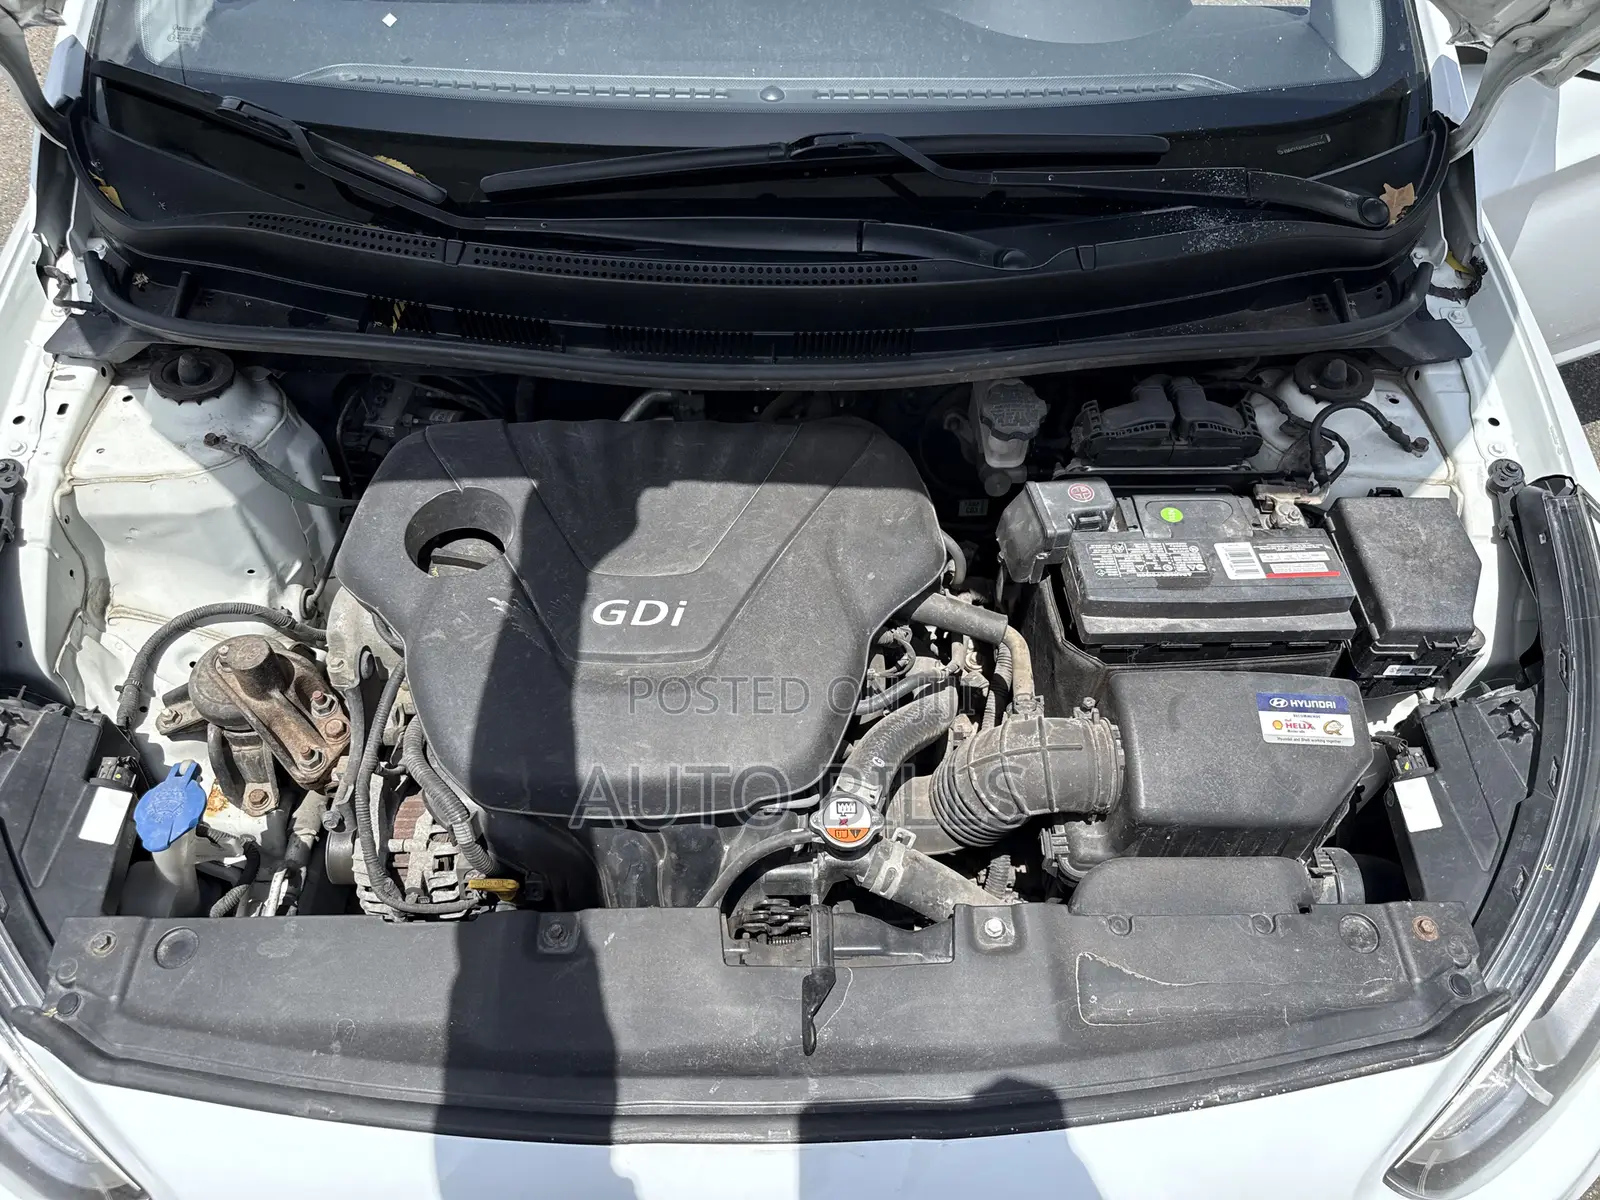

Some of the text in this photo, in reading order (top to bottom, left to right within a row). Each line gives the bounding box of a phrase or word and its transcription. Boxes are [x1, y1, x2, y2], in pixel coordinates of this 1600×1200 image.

[592, 600, 688, 627] GDi
[1290, 699, 1336, 709] HYUNDAI
[1285, 722, 1313, 730] HELIX
